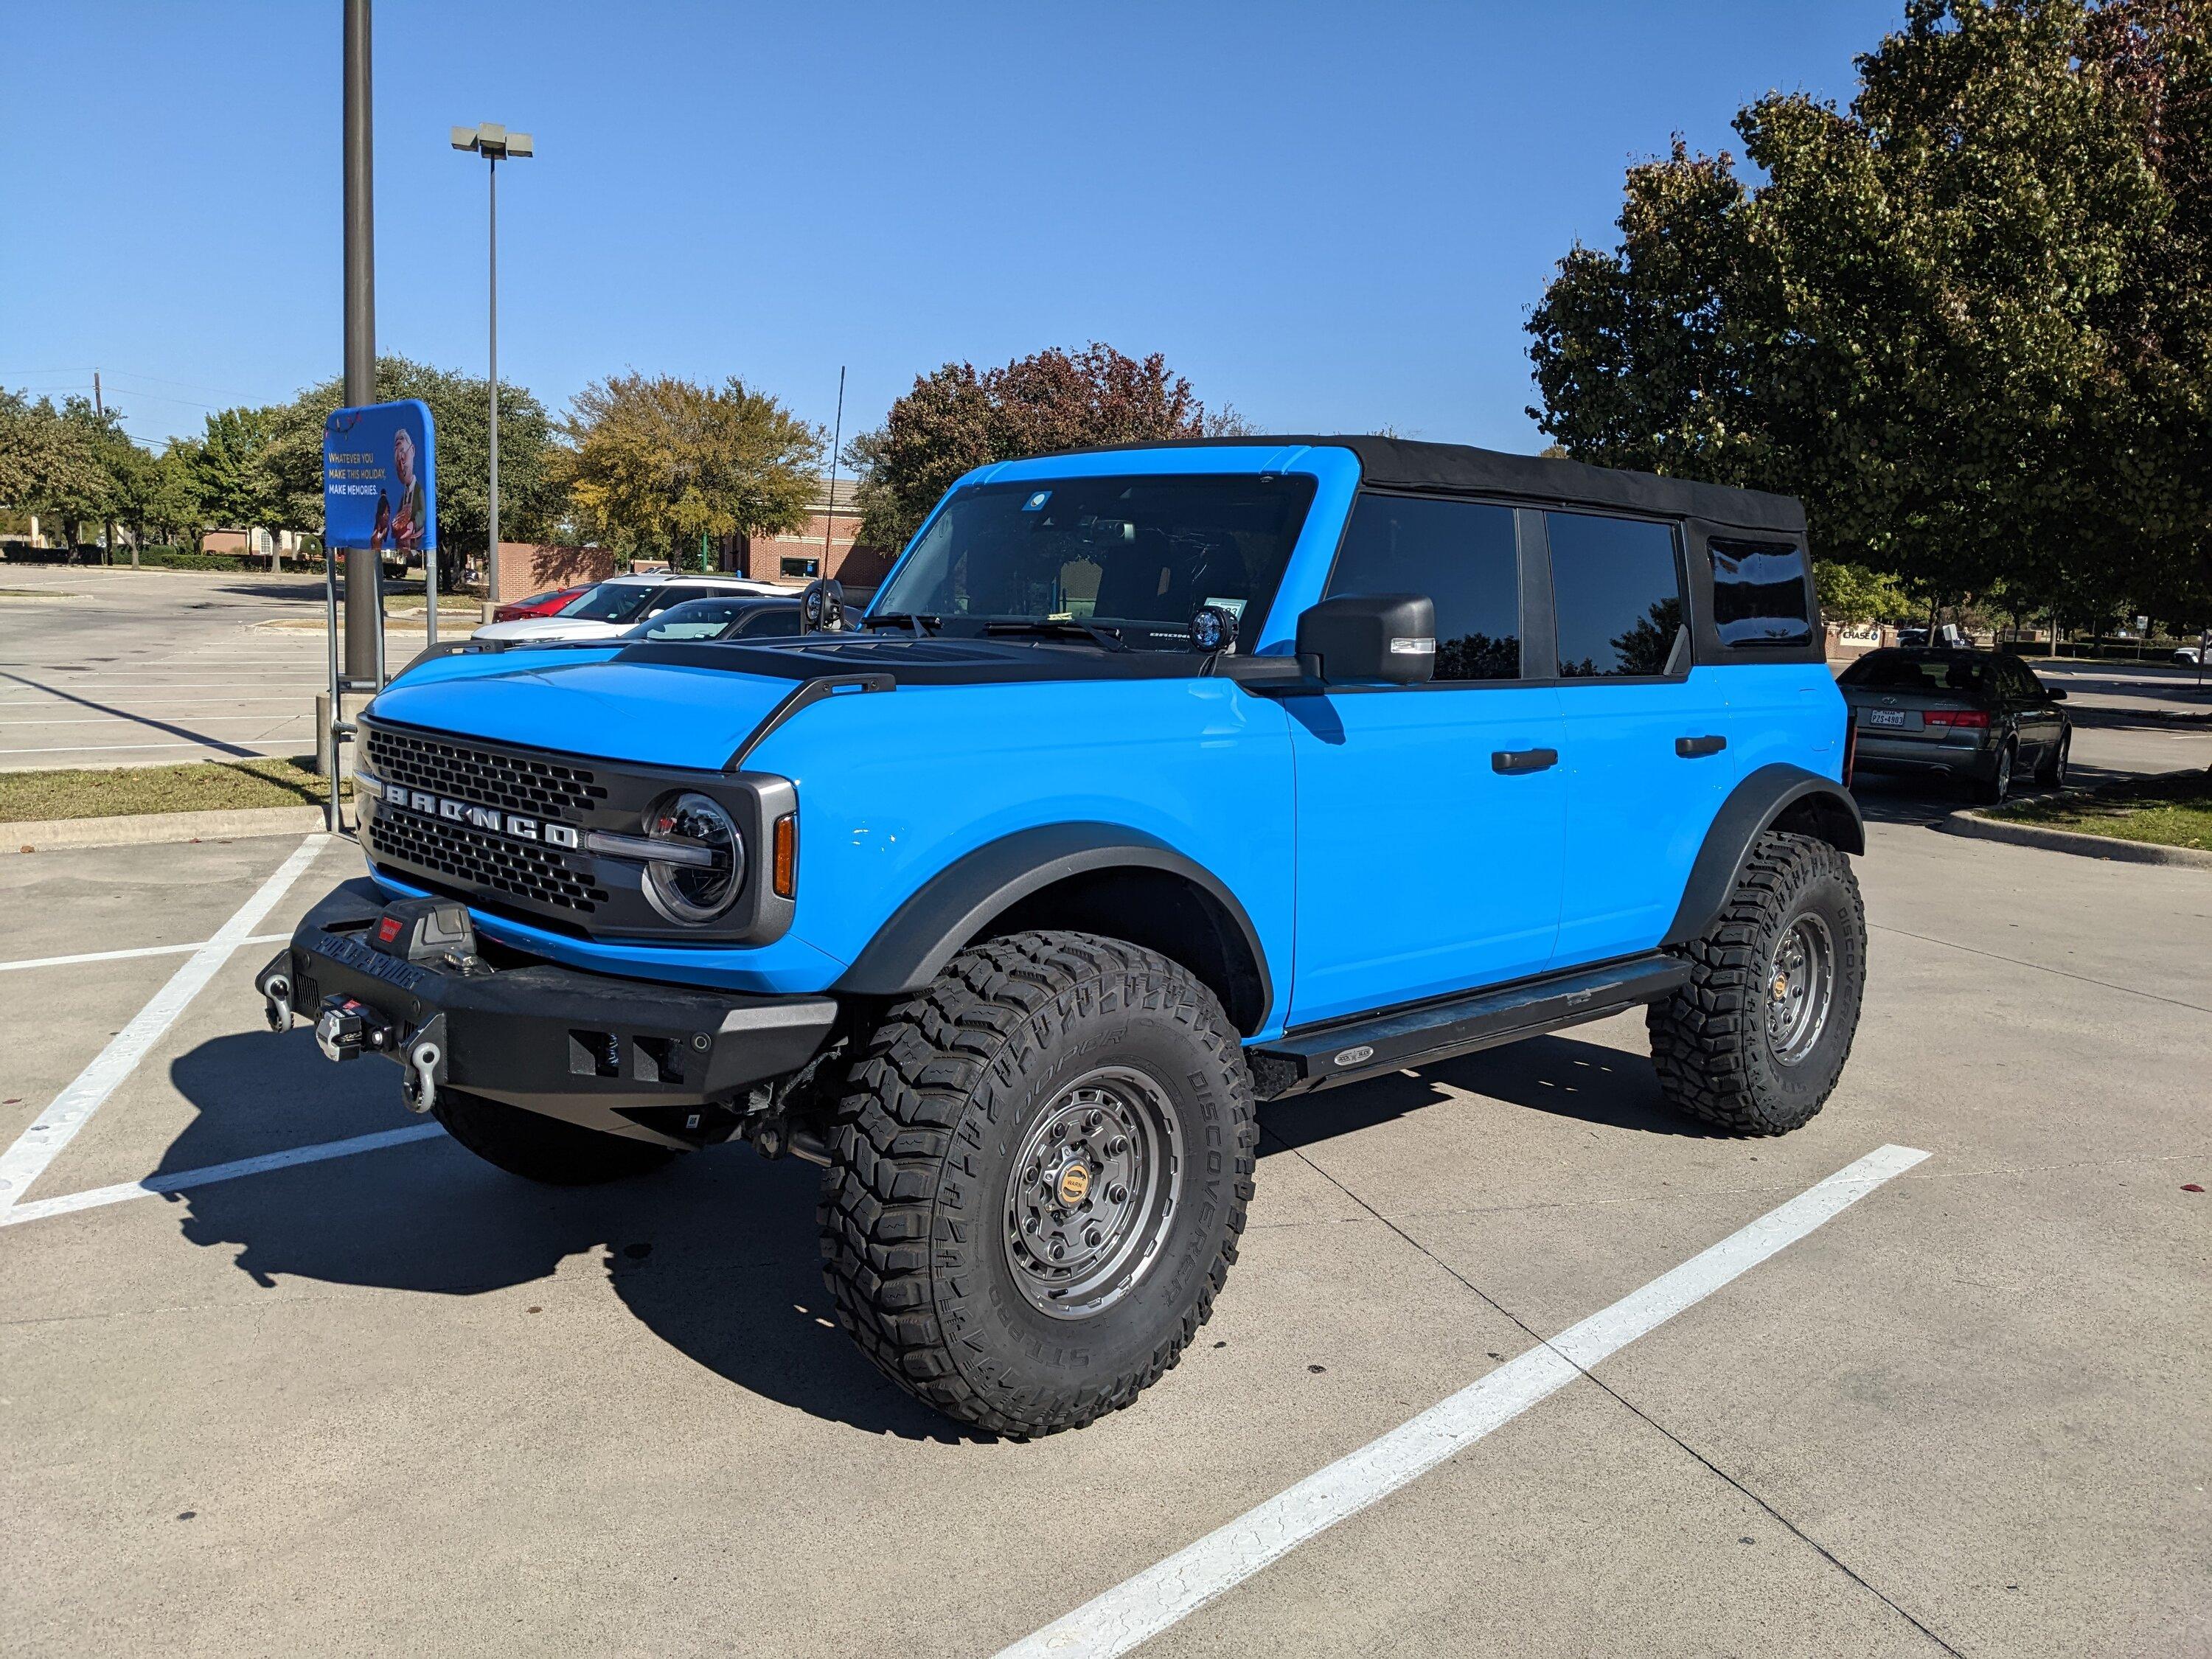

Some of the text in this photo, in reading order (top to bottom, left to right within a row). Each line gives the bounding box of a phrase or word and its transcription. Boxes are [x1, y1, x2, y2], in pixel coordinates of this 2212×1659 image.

[329, 453, 374, 464] WHATEVER YOU
[329, 469, 346, 479] MAKE
[347, 469, 360, 479] THIS
[329, 484, 378, 495] MAKE MEMORIES.
[1843, 631, 1870, 639] CHASE
[386, 785, 579, 849] BRONCO
[1067, 1180, 1082, 1188] WARN
[1161, 1070, 1222, 1307] DISCOVERER
